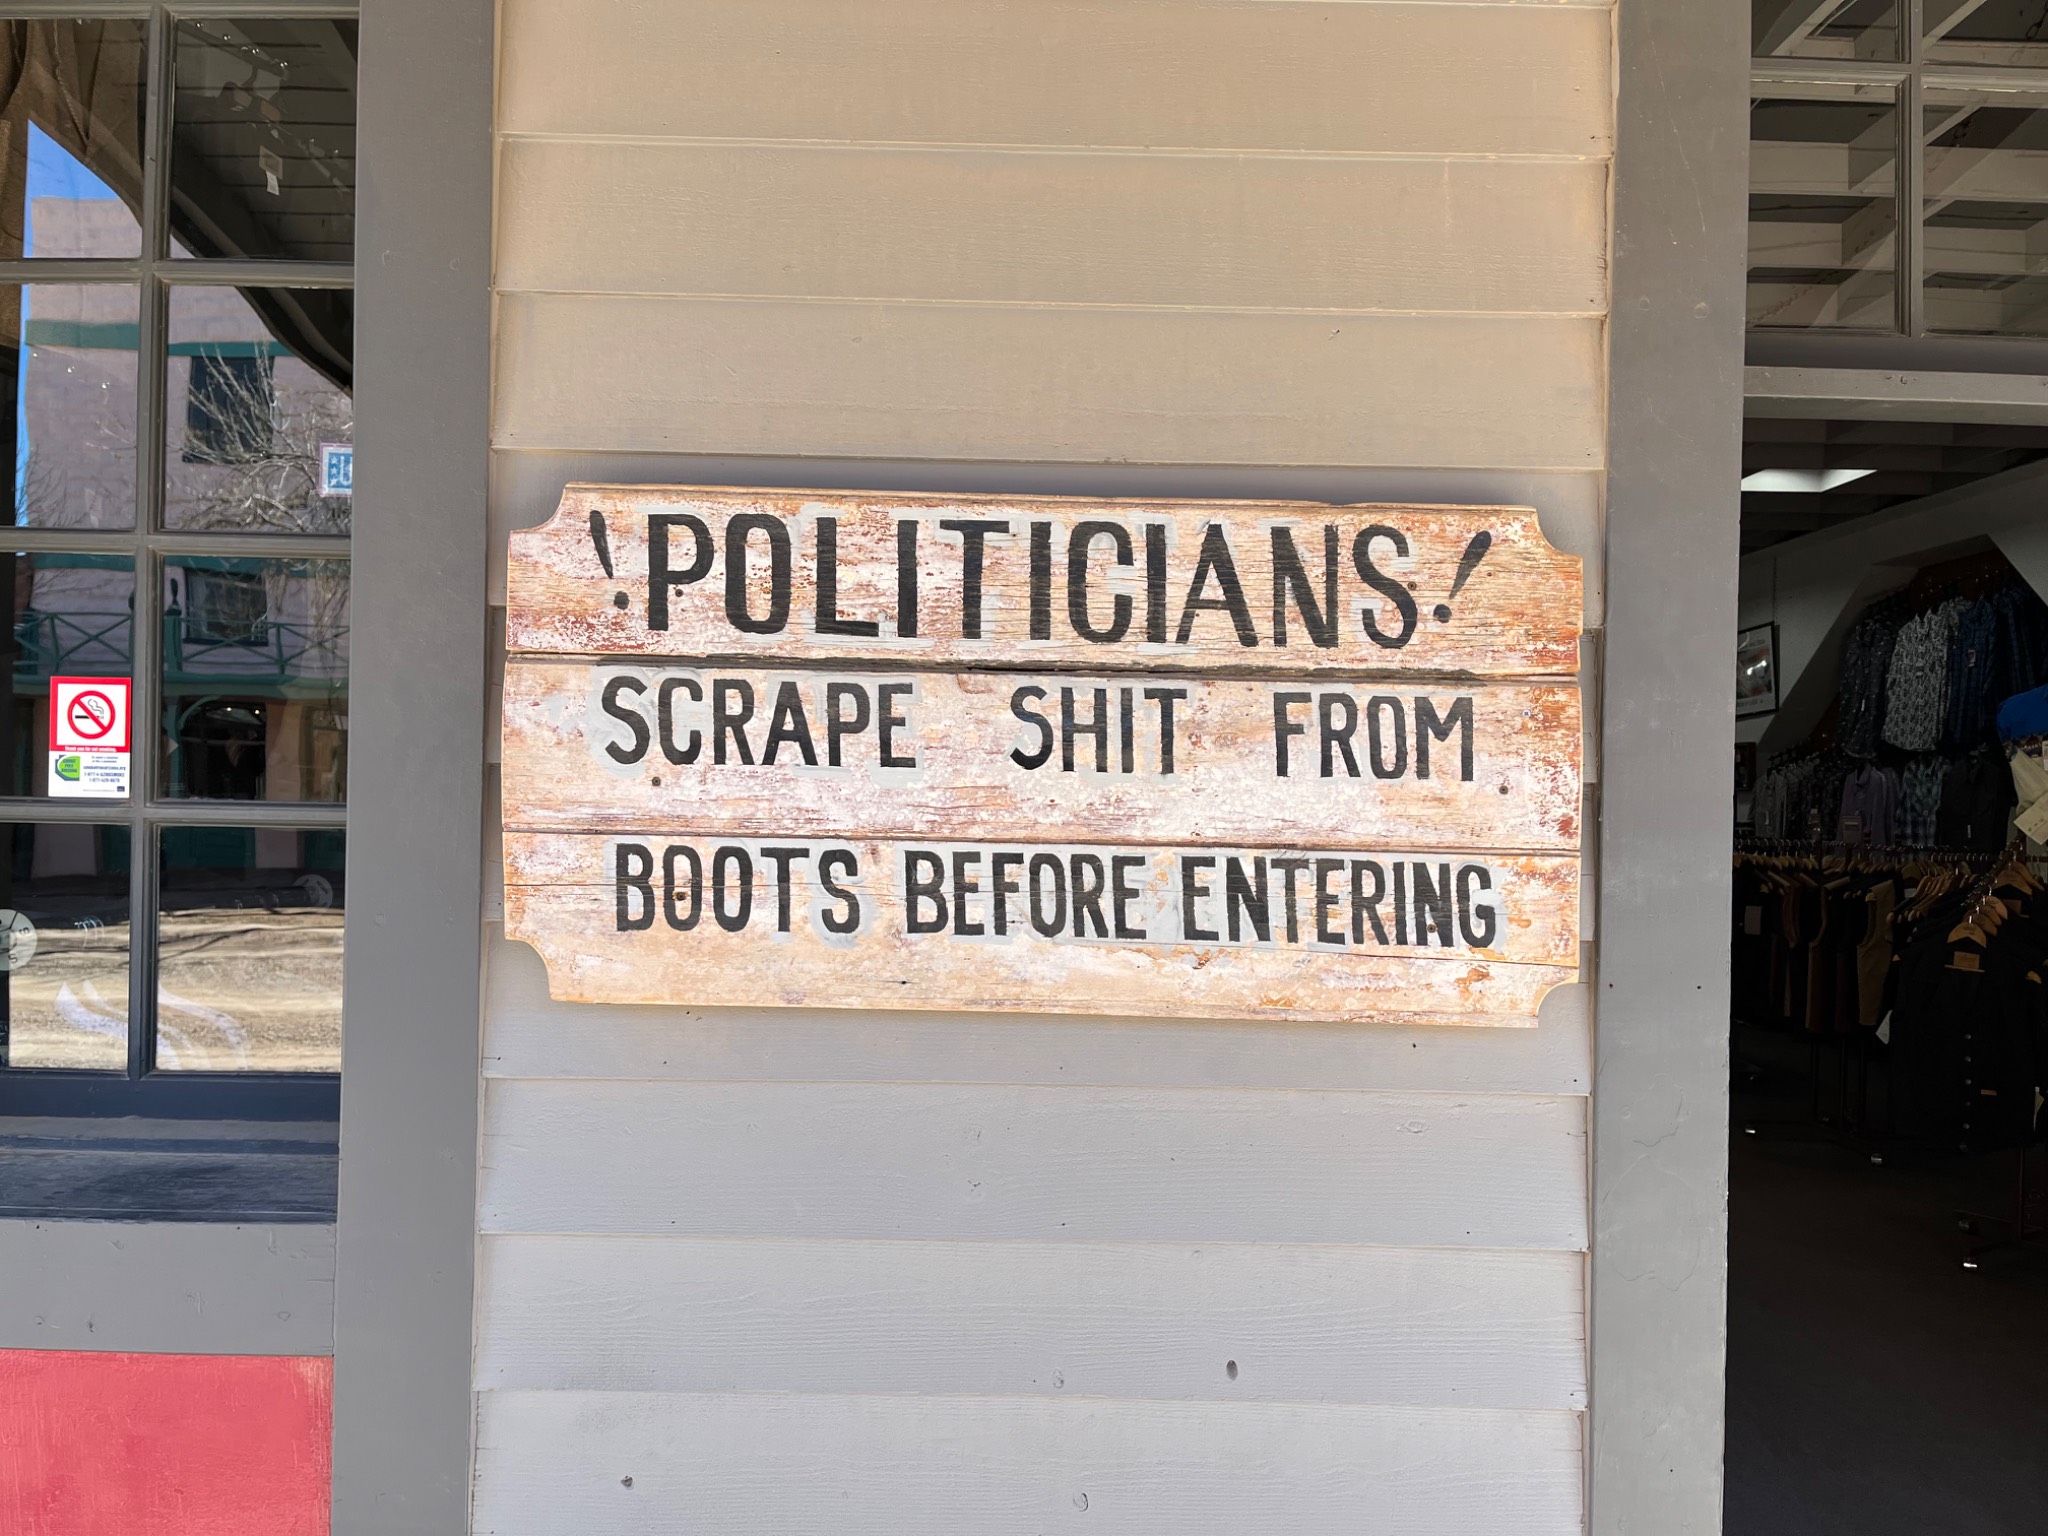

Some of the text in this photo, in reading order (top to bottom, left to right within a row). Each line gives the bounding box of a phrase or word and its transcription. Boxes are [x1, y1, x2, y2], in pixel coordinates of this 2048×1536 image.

[600, 676, 1474, 782] SCRAPE SHIT FROM
[616, 843, 1497, 949] BOOTS BEFORE ENTERING
